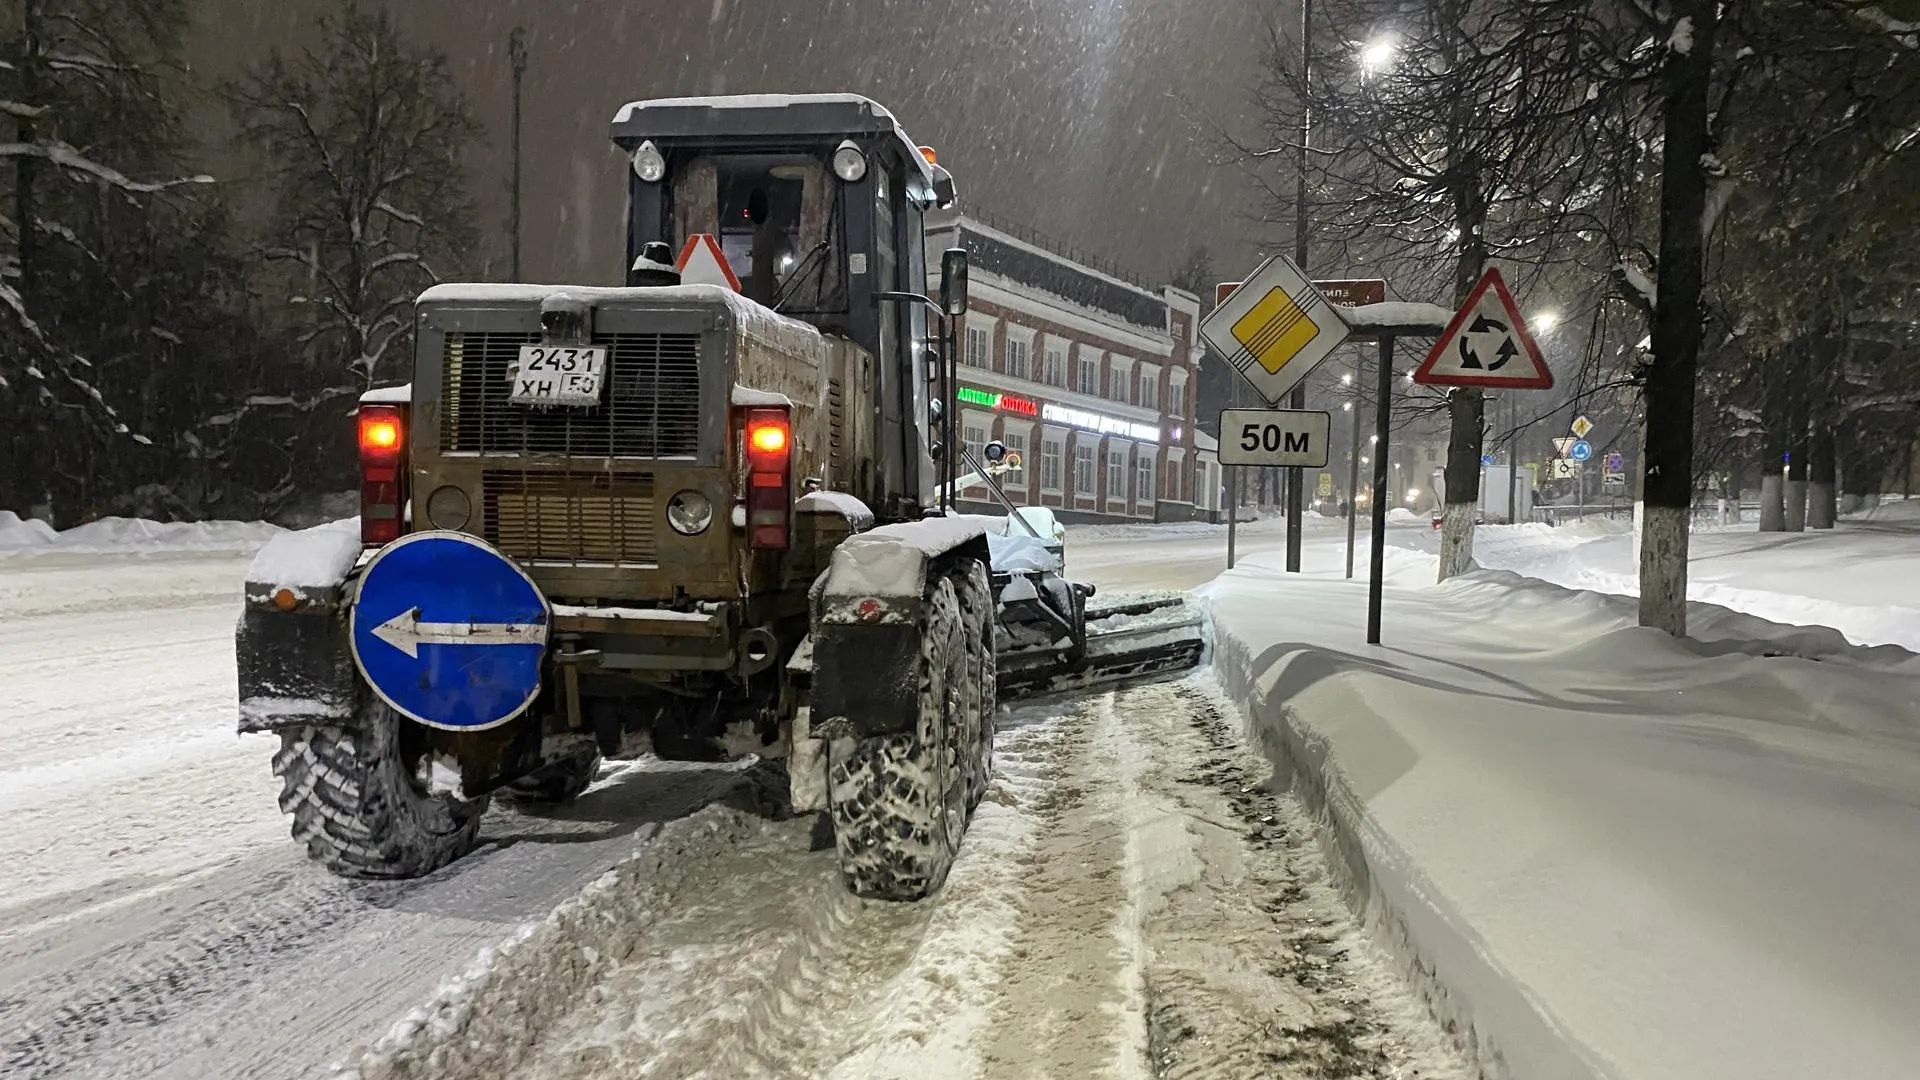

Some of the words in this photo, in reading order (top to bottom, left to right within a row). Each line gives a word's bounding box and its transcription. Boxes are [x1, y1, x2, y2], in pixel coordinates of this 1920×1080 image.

[528, 349, 594, 372] 2431
[520, 380, 553, 397] ХН
[958, 387, 996, 407] АПТЕКА
[1001, 395, 1037, 416] ОПТИКА
